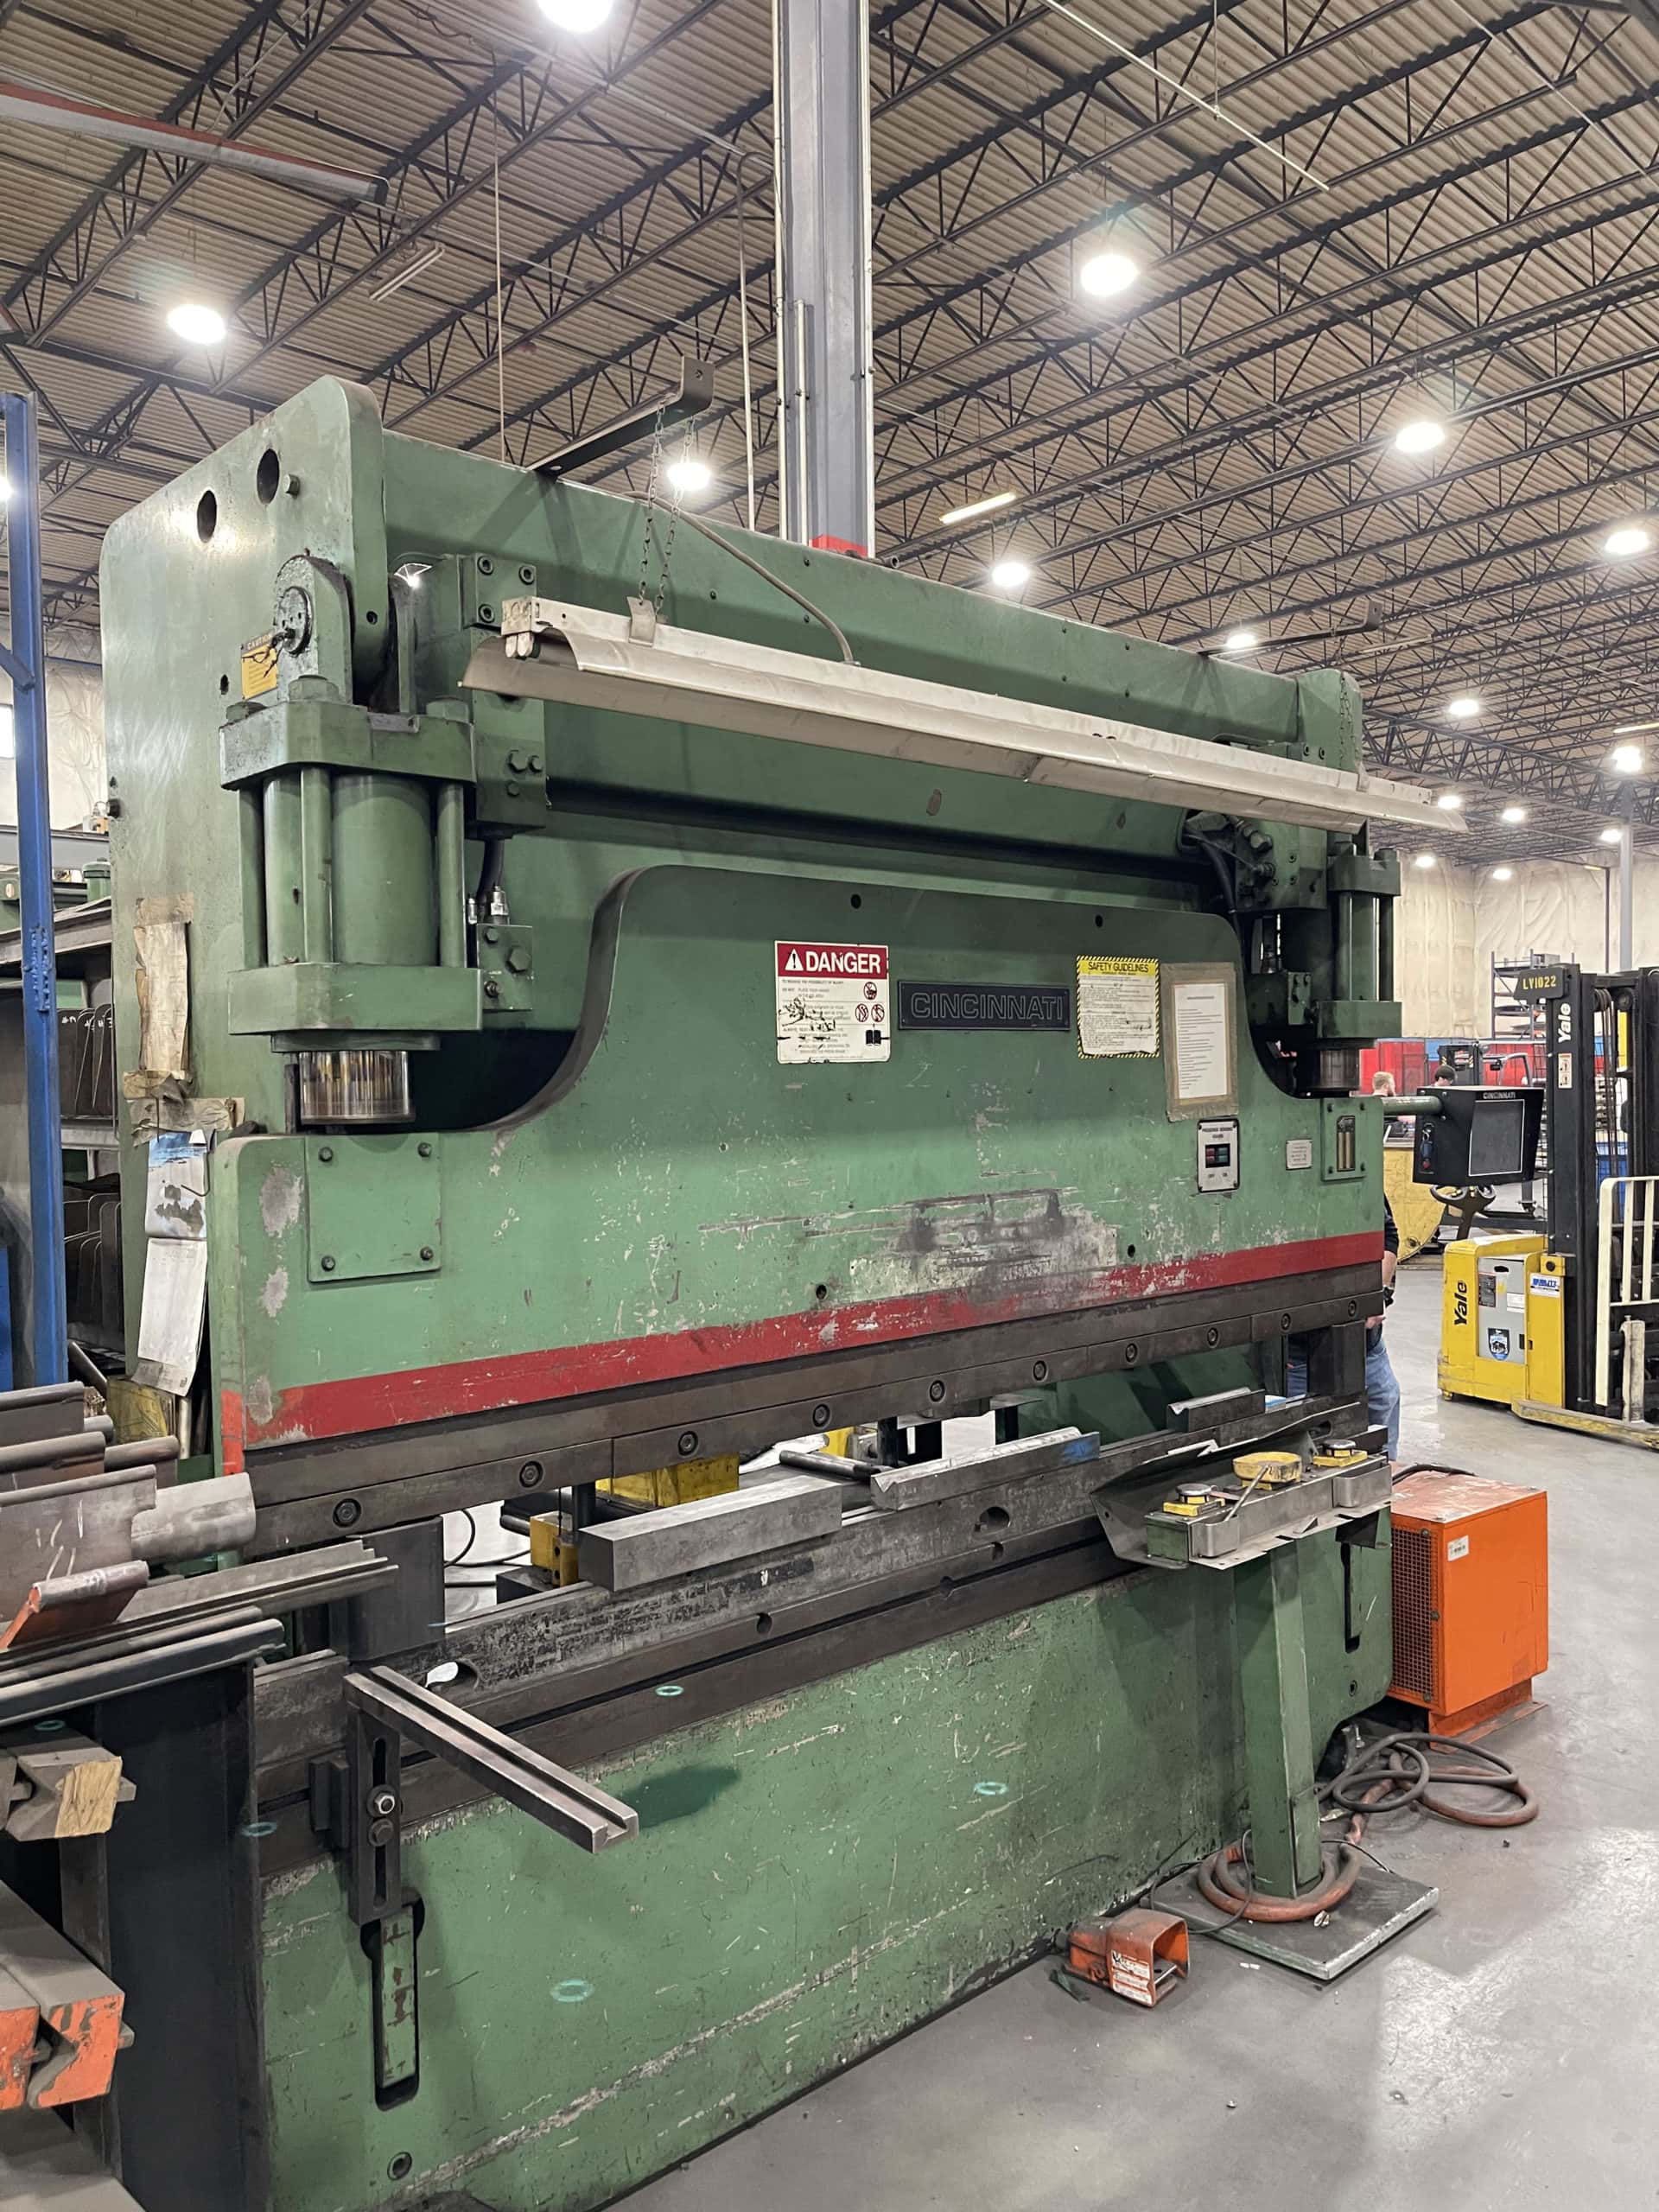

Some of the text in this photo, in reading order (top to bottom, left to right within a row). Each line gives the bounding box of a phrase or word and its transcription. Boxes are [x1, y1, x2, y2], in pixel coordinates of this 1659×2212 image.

[247, 632, 272, 651] CAUTIO
[805, 950, 881, 974] DANGER
[1088, 961, 1149, 973] SAFETY GUIDELINES
[911, 992, 1063, 1020] CINCINNATI
[1558, 1002, 1572, 1043] Yale
[1483, 1091, 1516, 1100] CINCINNATI
[1454, 1280, 1468, 1325] Yale
